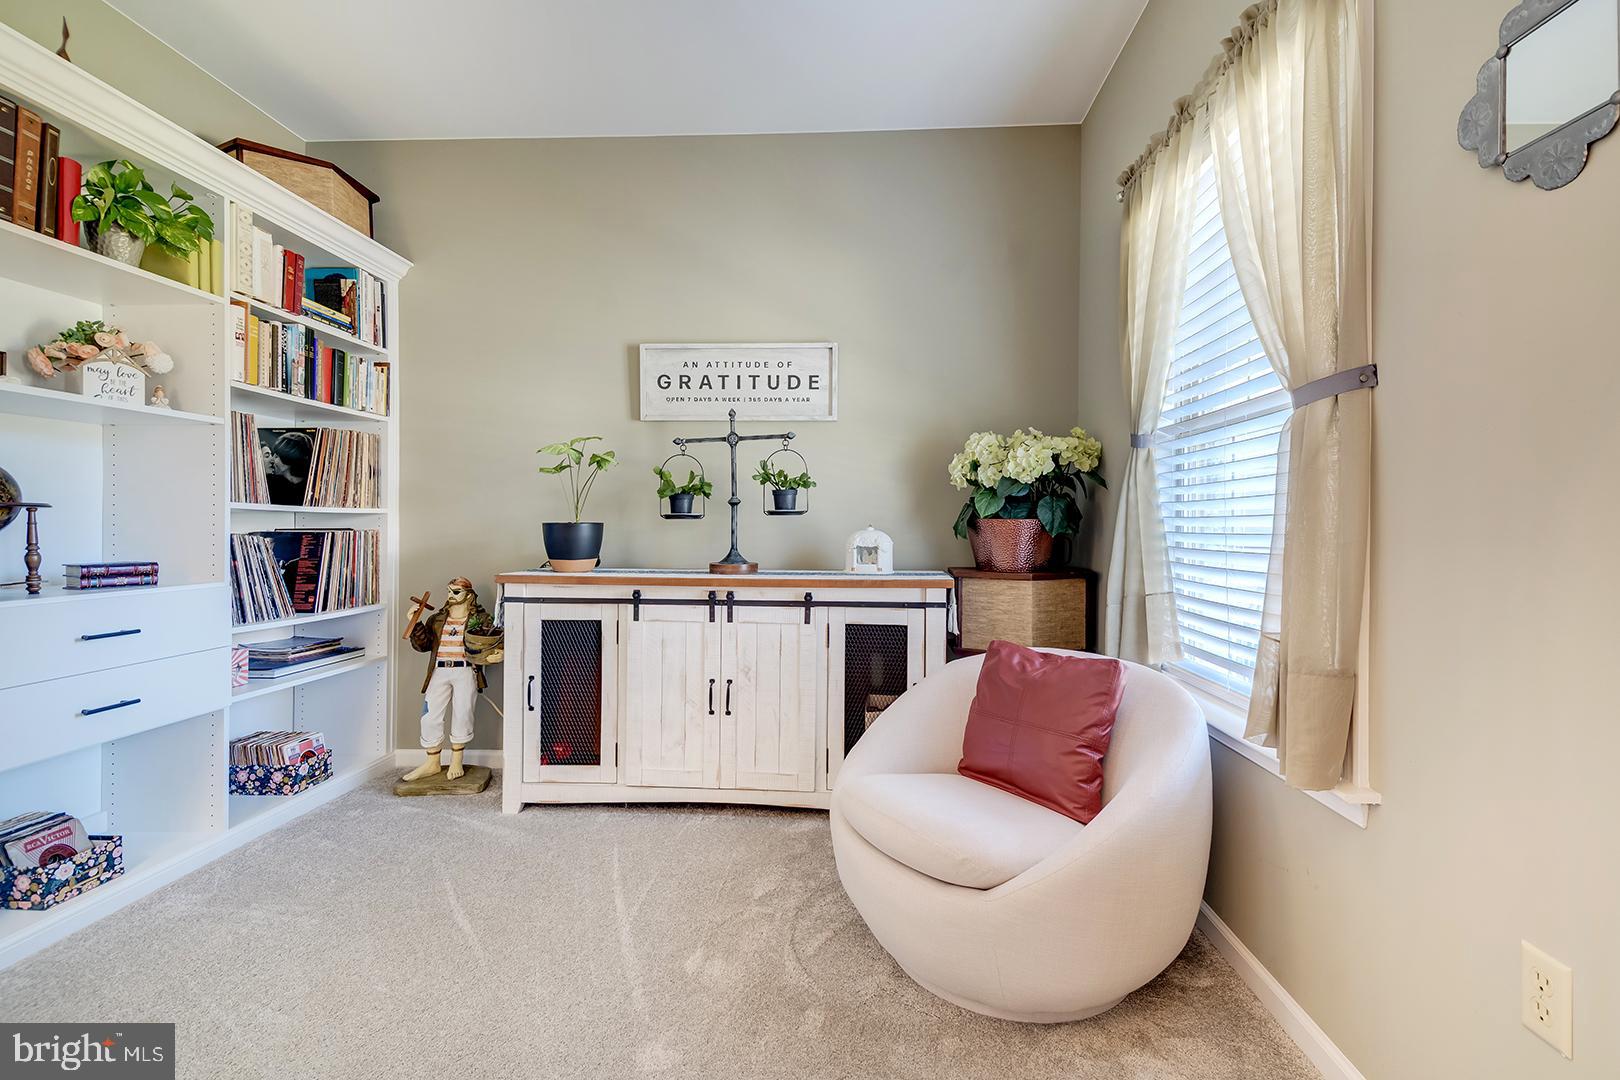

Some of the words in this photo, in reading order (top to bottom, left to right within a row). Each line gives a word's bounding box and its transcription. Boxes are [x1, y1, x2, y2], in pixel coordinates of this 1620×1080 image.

[117, 366, 136, 379] love
[101, 382, 136, 397] heart
[657, 374, 820, 390] GRATITUDE
